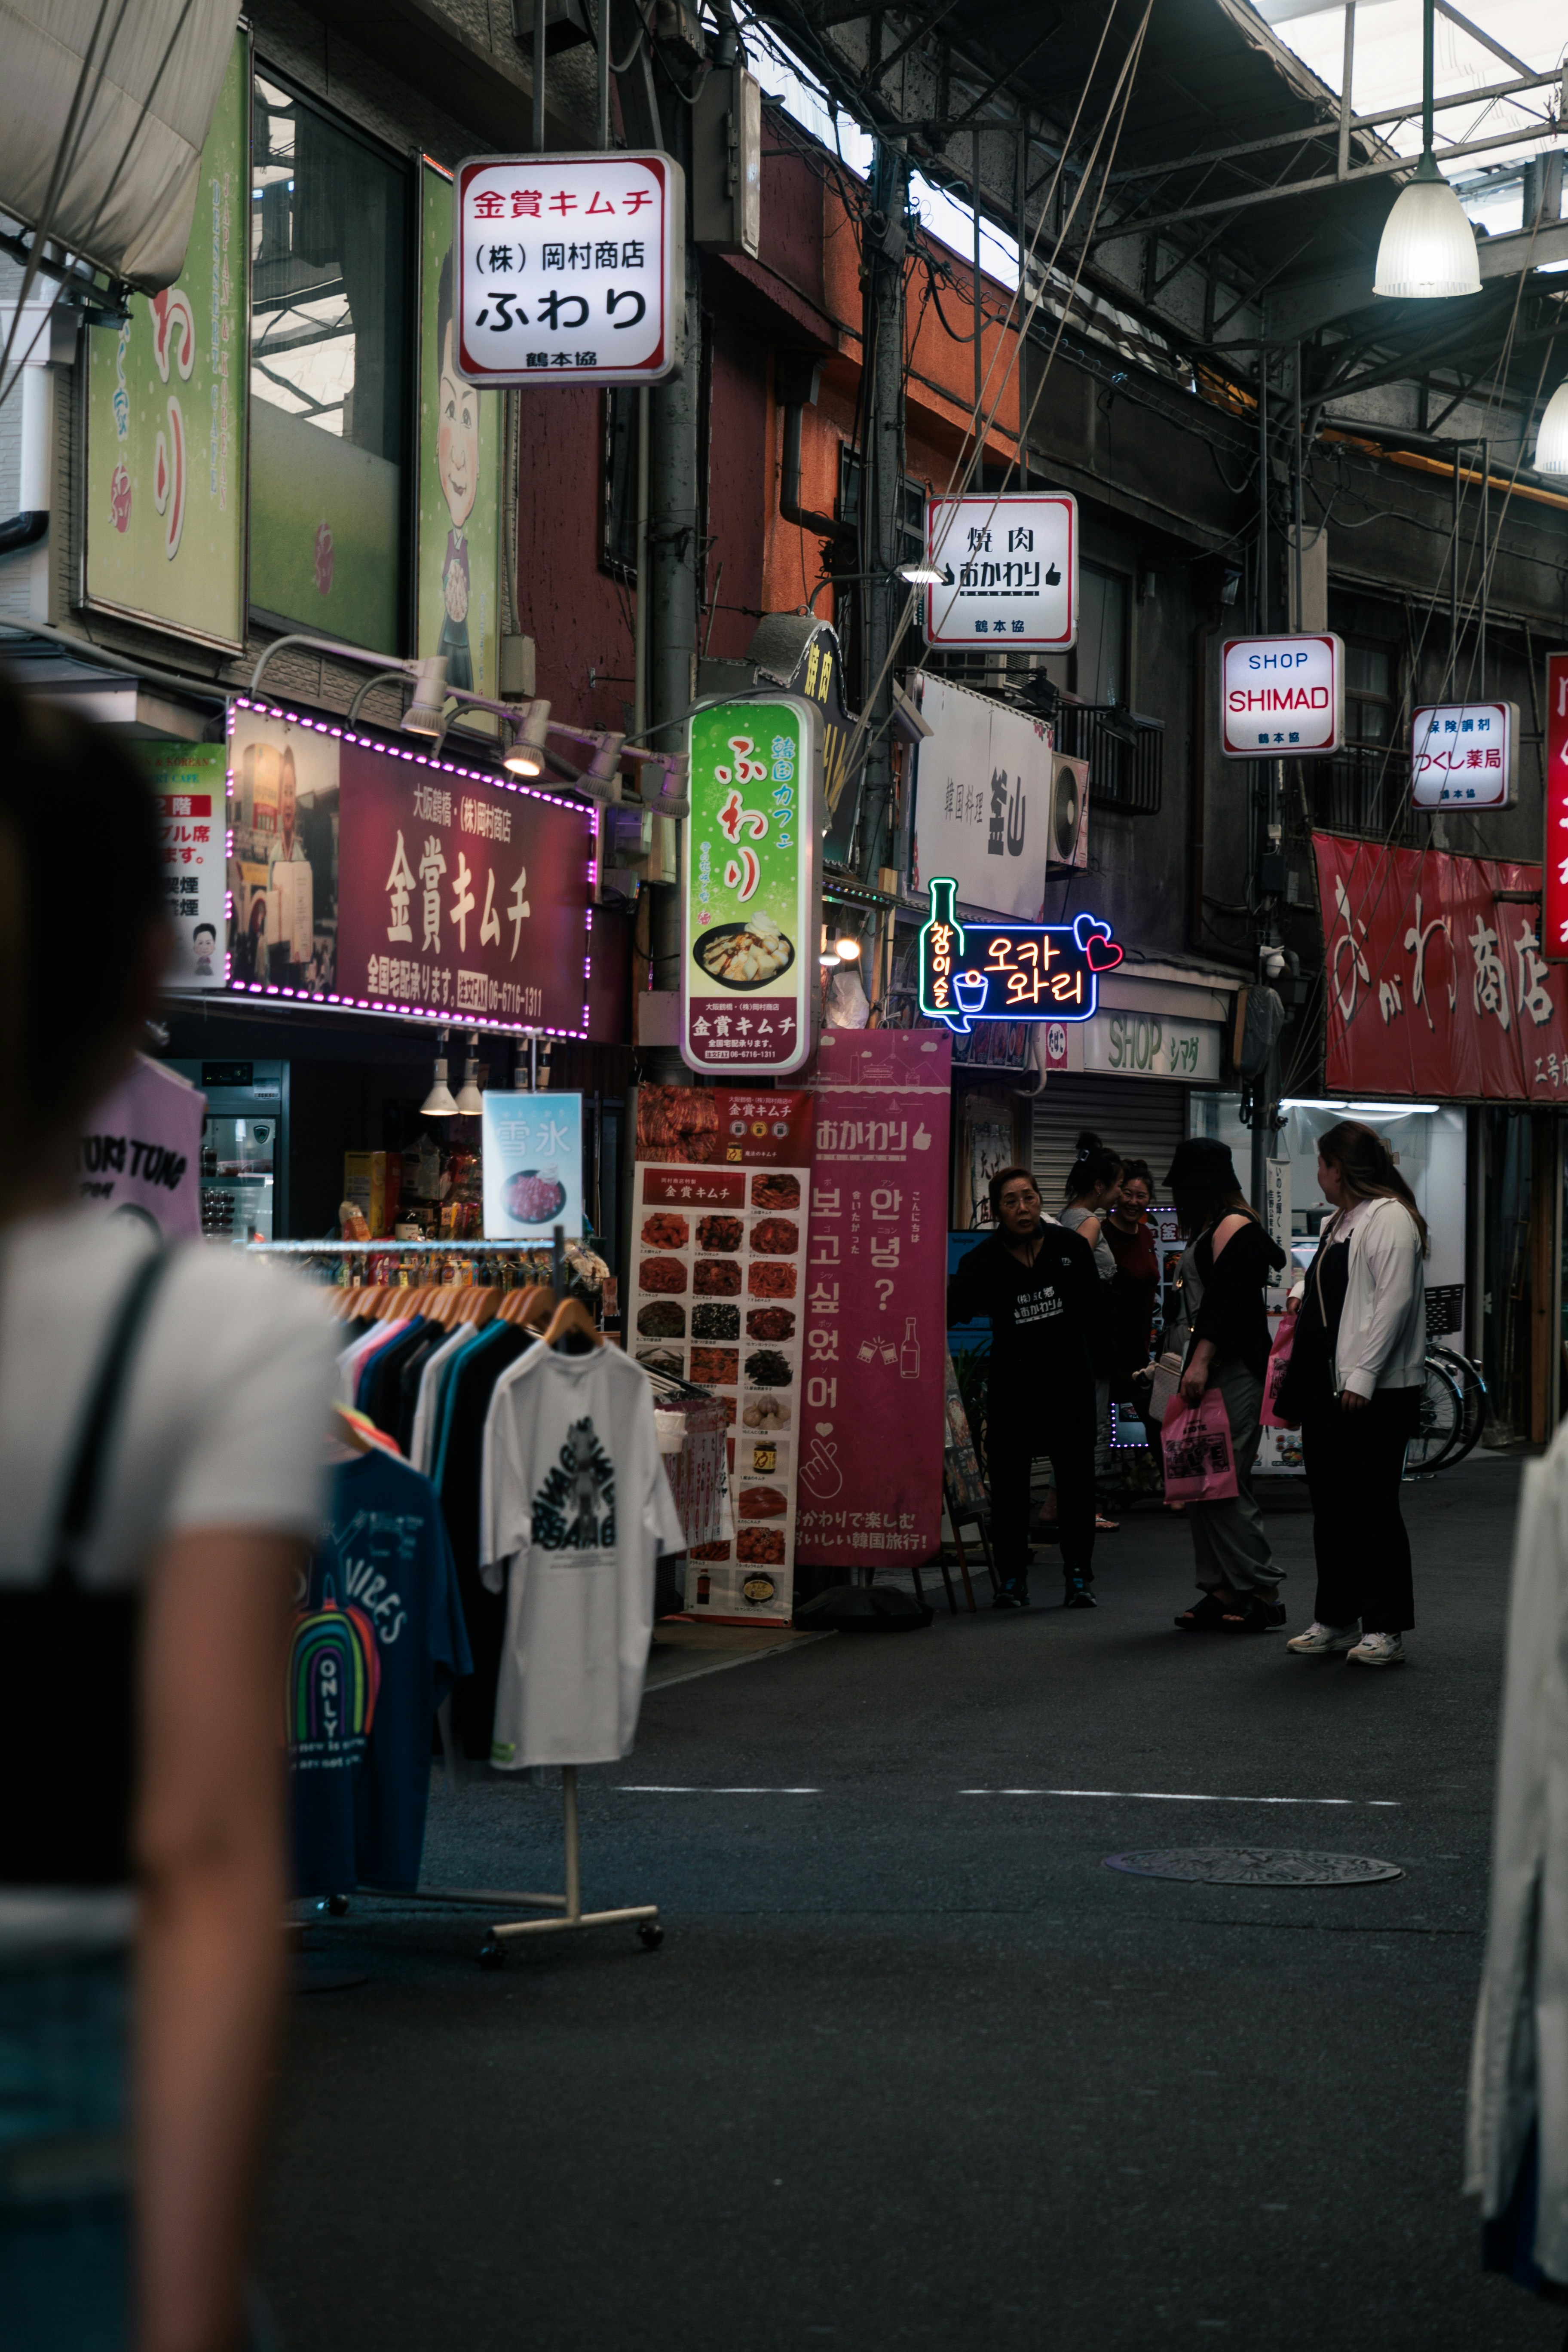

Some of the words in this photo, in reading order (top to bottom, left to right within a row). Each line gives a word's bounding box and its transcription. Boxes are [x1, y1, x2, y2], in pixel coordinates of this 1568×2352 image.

[473, 190, 653, 219] 金賞キムチ
[542, 239, 644, 271] 岡村商店
[475, 288, 646, 332] ふわり
[526, 352, 597, 367] 鶴本協
[220, 351, 228, 511] KOREAN
[960, 562, 1040, 587] おかわり
[975, 620, 1024, 633] 鶴本協
[1249, 653, 1308, 670] SHOP
[1229, 686, 1329, 712] SHIMAD
[1258, 732, 1300, 744] 鶴本協
[1429, 718, 1490, 733] 保険調剤
[1415, 748, 1501, 772] つくし薬局
[771, 735, 795, 848] 韓国カフェ
[945, 776, 983, 827] 韓国料理
[1440, 789, 1476, 799] 鶴本協
[715, 736, 769, 902] ふわり
[988, 766, 1026, 857] 釜山
[385, 829, 530, 963] 金賞キムチ
[931, 922, 953, 1008] 참이슬
[984, 935, 1060, 971] 오카
[1334, 874, 1555, 1032] おがわ商店
[367, 954, 455, 1008] 全国宅配承ります。
[489, 980, 542, 1017] 06-6716-1311
[1006, 967, 1081, 1004] 와리
[692, 1016, 796, 1037] 金賞キムチ
[708, 1039, 772, 1048] 全国宅配承ります。
[1049, 1030, 1064, 1053] たばこ
[1109, 1015, 1162, 1070] SHOP
[1171, 1037, 1199, 1073] シマダ
[728, 1103, 791, 1117] 金賞キムチ
[496, 1120, 570, 1157] 雪氷
[817, 1120, 907, 1151] おかわり
[665, 1185, 730, 1199] 金賞キムチ
[851, 1191, 861, 1254] 会いたかった
[911, 1191, 920, 1243] こんにちは
[1020, 1299, 1056, 1317] おかわり
[346, 1556, 407, 1645] VIBES
[319, 1659, 338, 1739] ONLY
